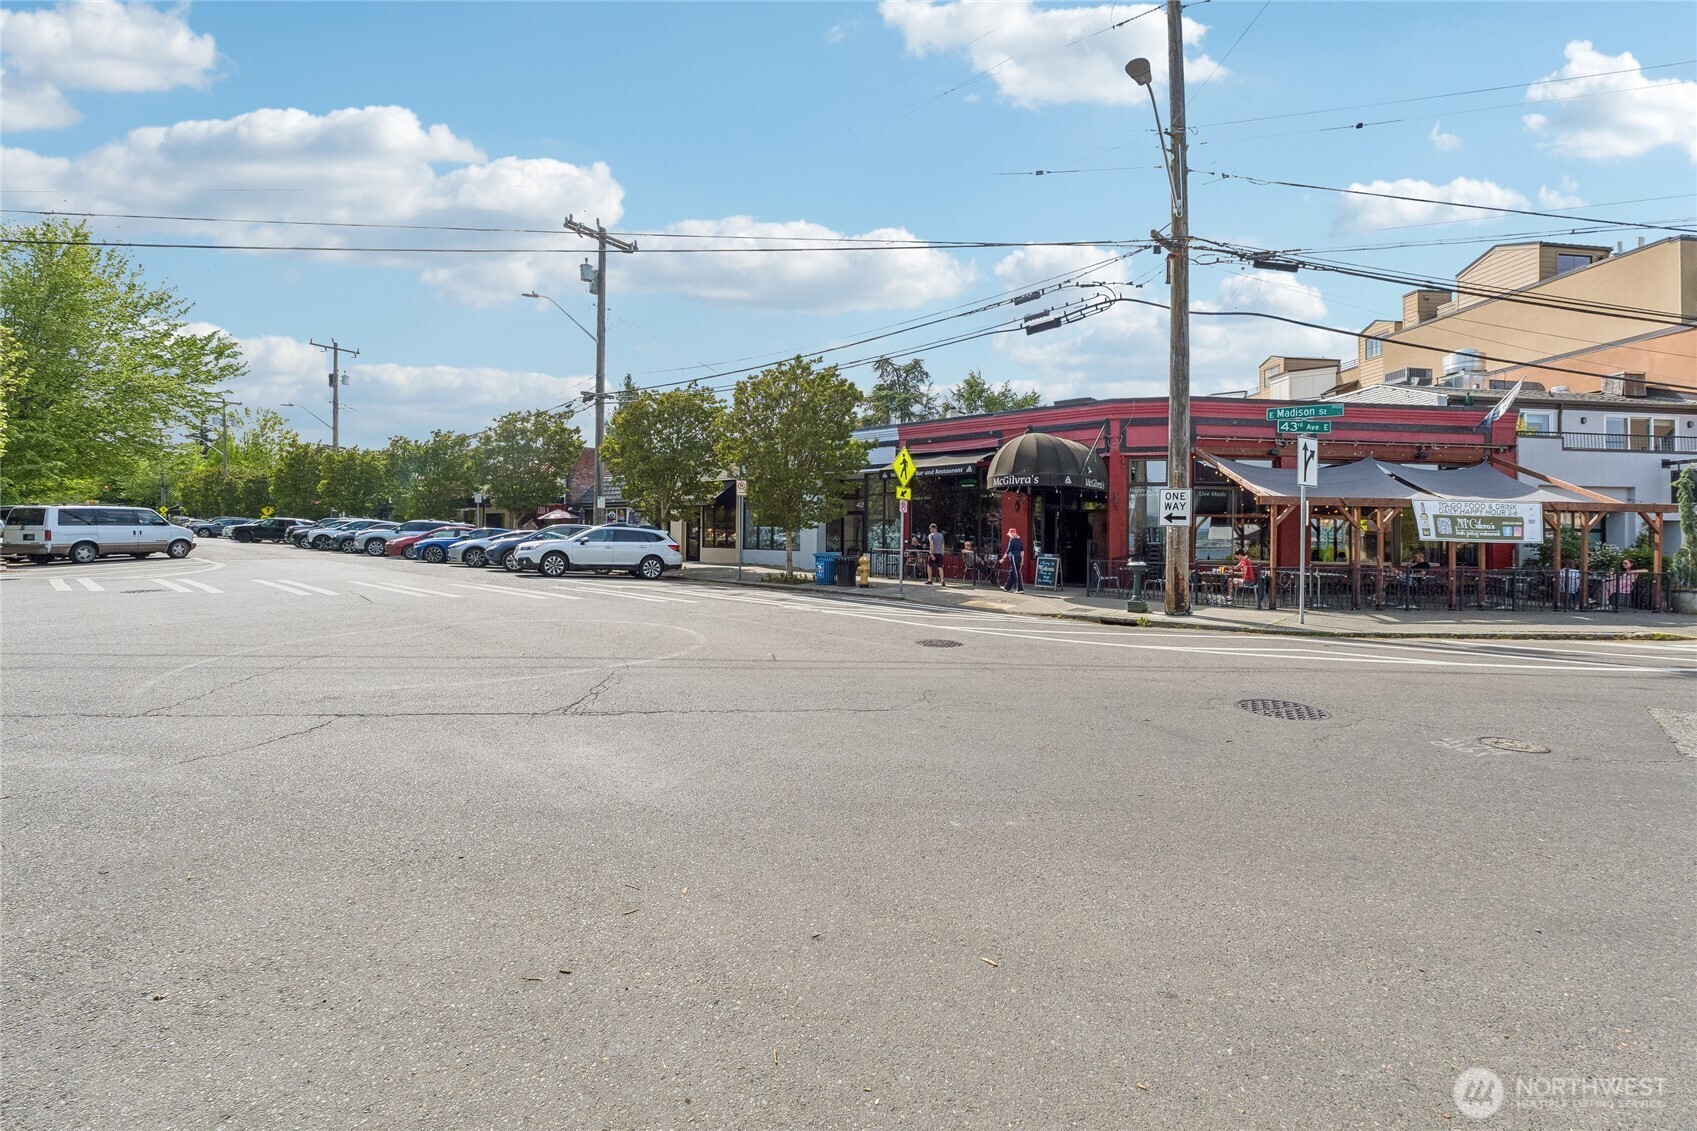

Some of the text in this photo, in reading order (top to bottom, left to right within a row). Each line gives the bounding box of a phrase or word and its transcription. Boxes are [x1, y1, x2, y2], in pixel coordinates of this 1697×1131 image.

[1277, 408, 1315, 418] Madison
[1280, 422, 1303, 431] 43rd
[935, 467, 963, 475] Restaurant
[993, 474, 1039, 486] McGilvra's
[1165, 492, 1186, 501] ONE
[1164, 502, 1187, 511] WAY
[1464, 502, 1486, 510] FOOD
